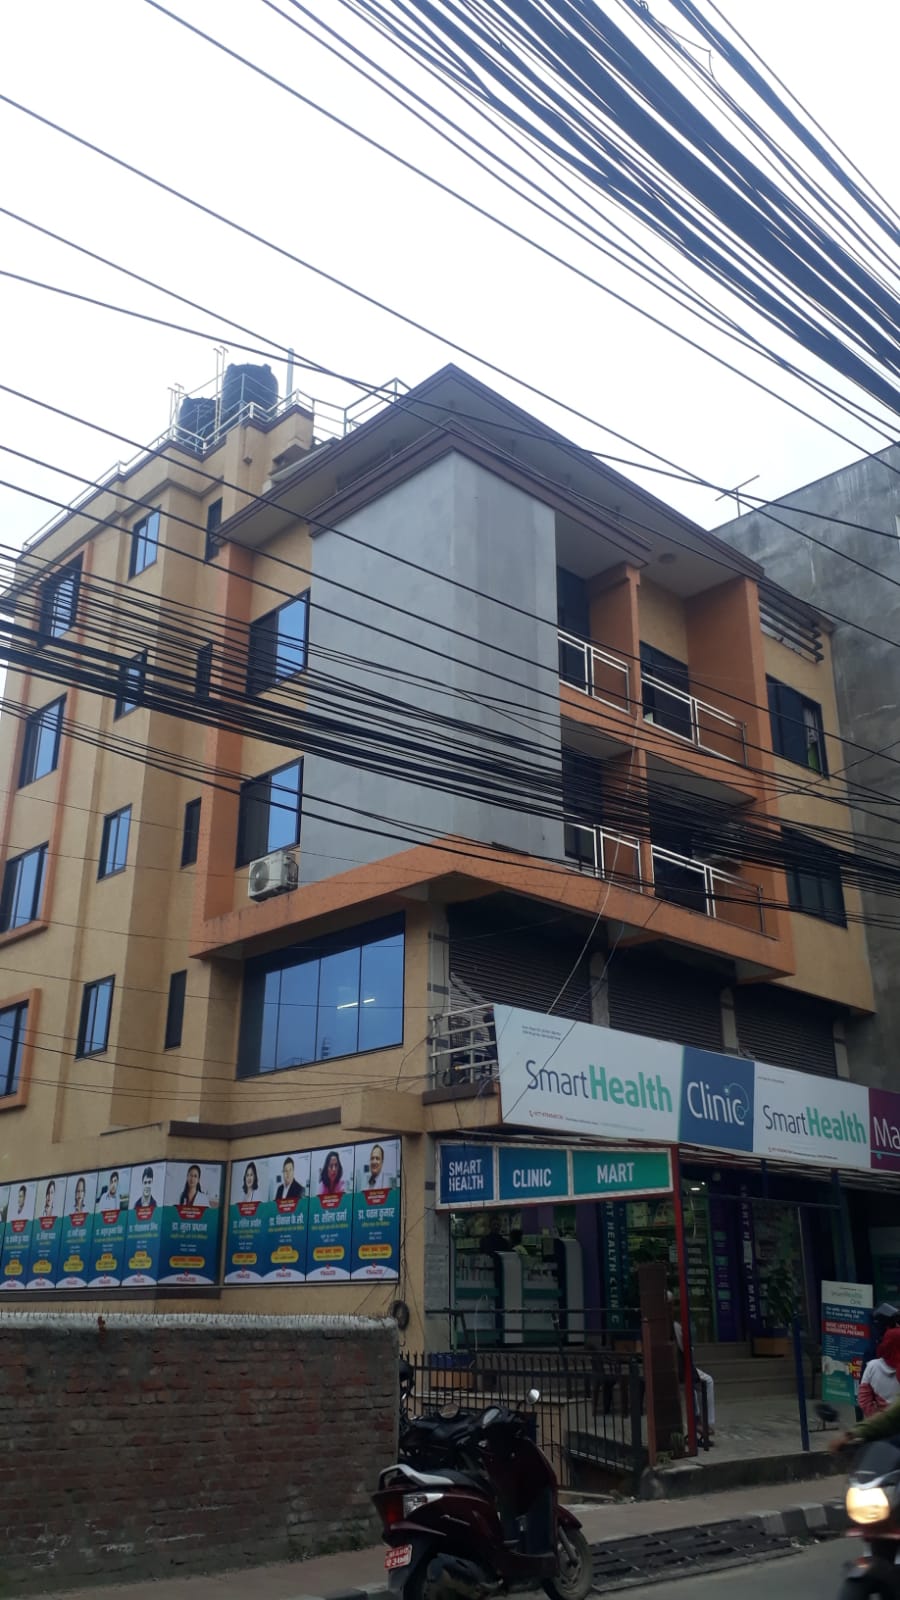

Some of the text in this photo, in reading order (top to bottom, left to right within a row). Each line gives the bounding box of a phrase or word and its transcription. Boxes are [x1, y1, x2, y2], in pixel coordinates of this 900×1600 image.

[525, 1059, 673, 1113] SmartHealth
[687, 1081, 745, 1126] Clinic
[762, 1104, 867, 1145] SmartHealth
[449, 1159, 482, 1176] SMART
[449, 1175, 484, 1192] HEALTH
[512, 1169, 552, 1188] CLINIC
[596, 1162, 635, 1184] MART
[606, 1221, 617, 1272] HEALTH
[609, 1276, 620, 1324] CLINC
